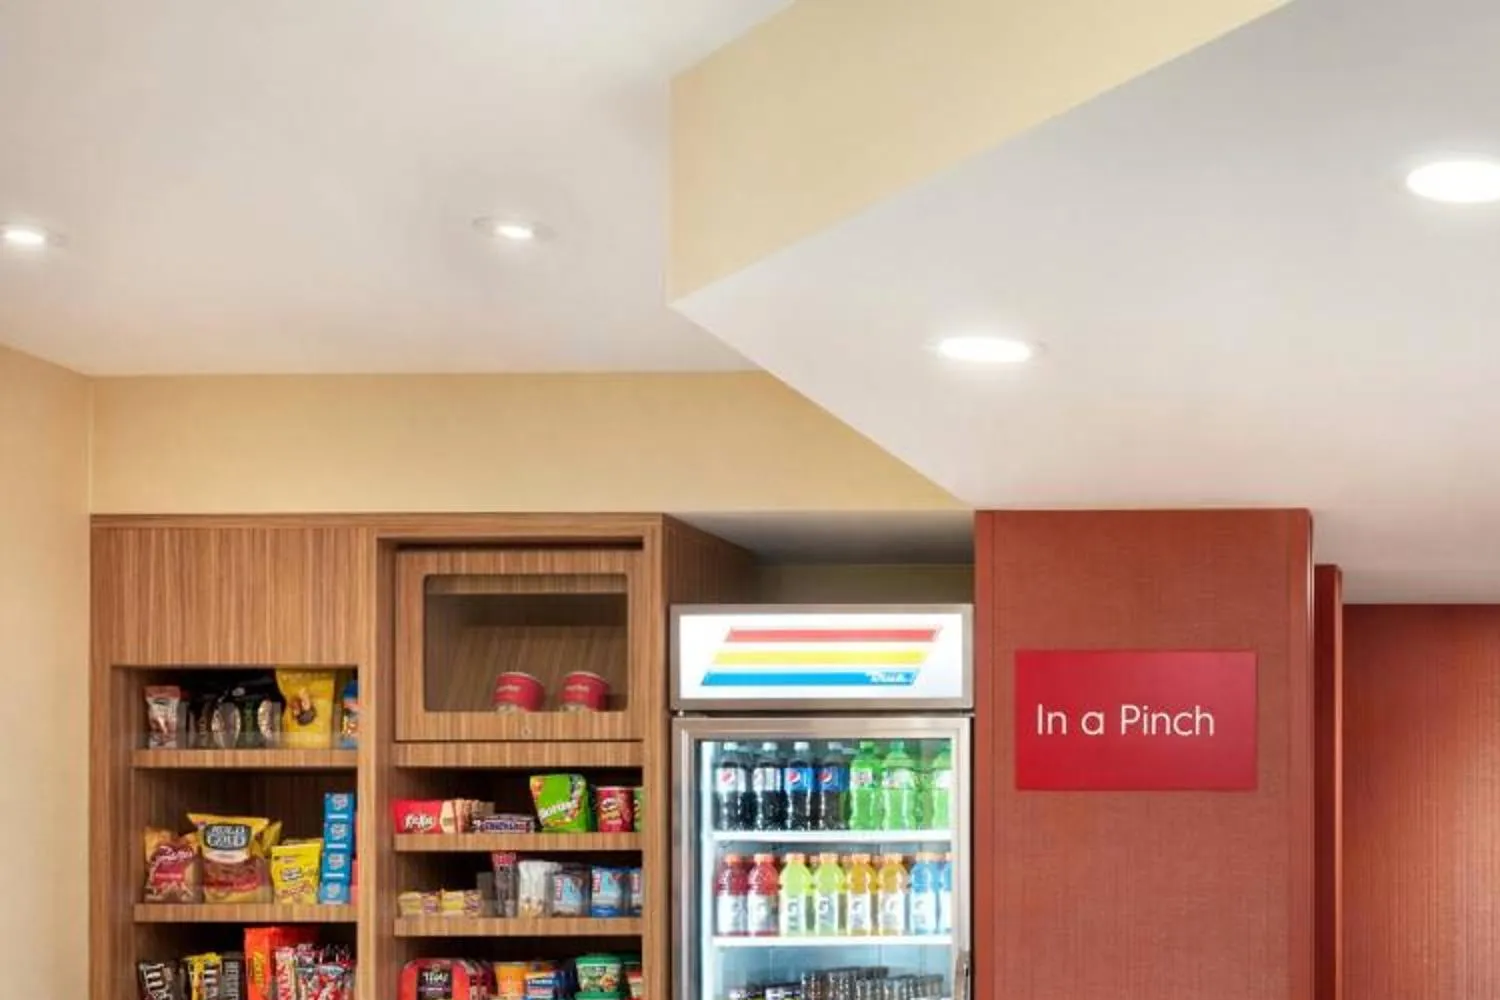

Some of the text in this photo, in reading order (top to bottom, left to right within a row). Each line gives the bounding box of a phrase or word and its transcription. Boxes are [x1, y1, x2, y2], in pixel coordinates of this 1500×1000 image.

[1037, 703, 1214, 736] In a Pinch
